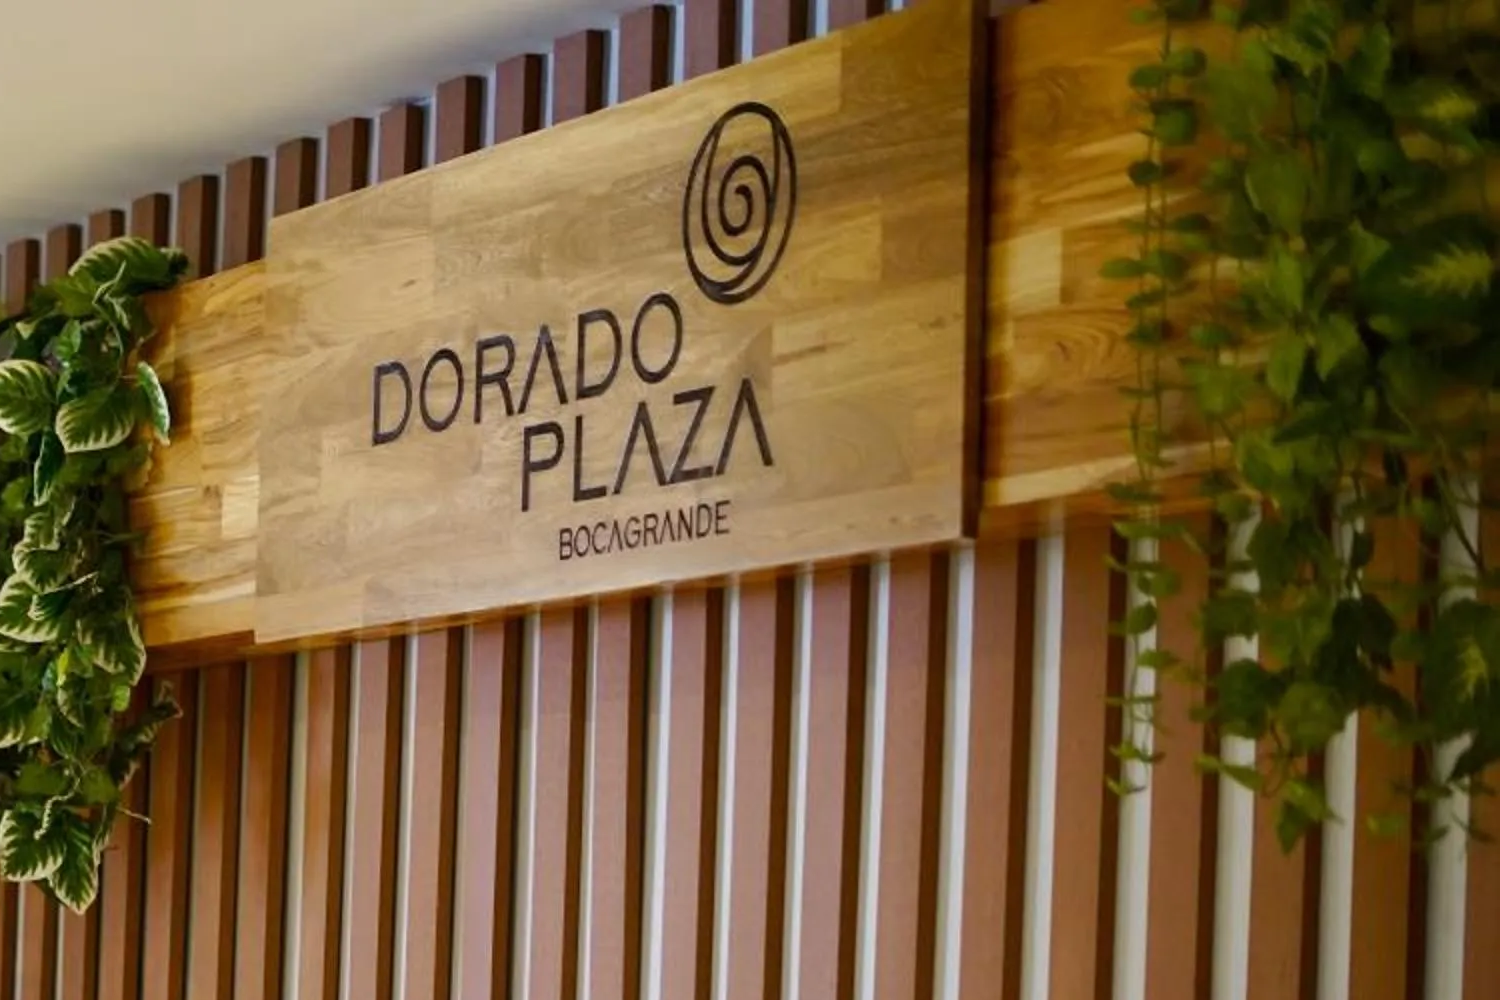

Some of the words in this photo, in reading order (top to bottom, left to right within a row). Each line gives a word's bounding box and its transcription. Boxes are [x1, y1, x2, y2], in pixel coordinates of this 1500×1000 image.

[371, 292, 684, 447] DORADO
[520, 377, 775, 513] PLAZA
[558, 500, 732, 561] BOCAGRANDE
